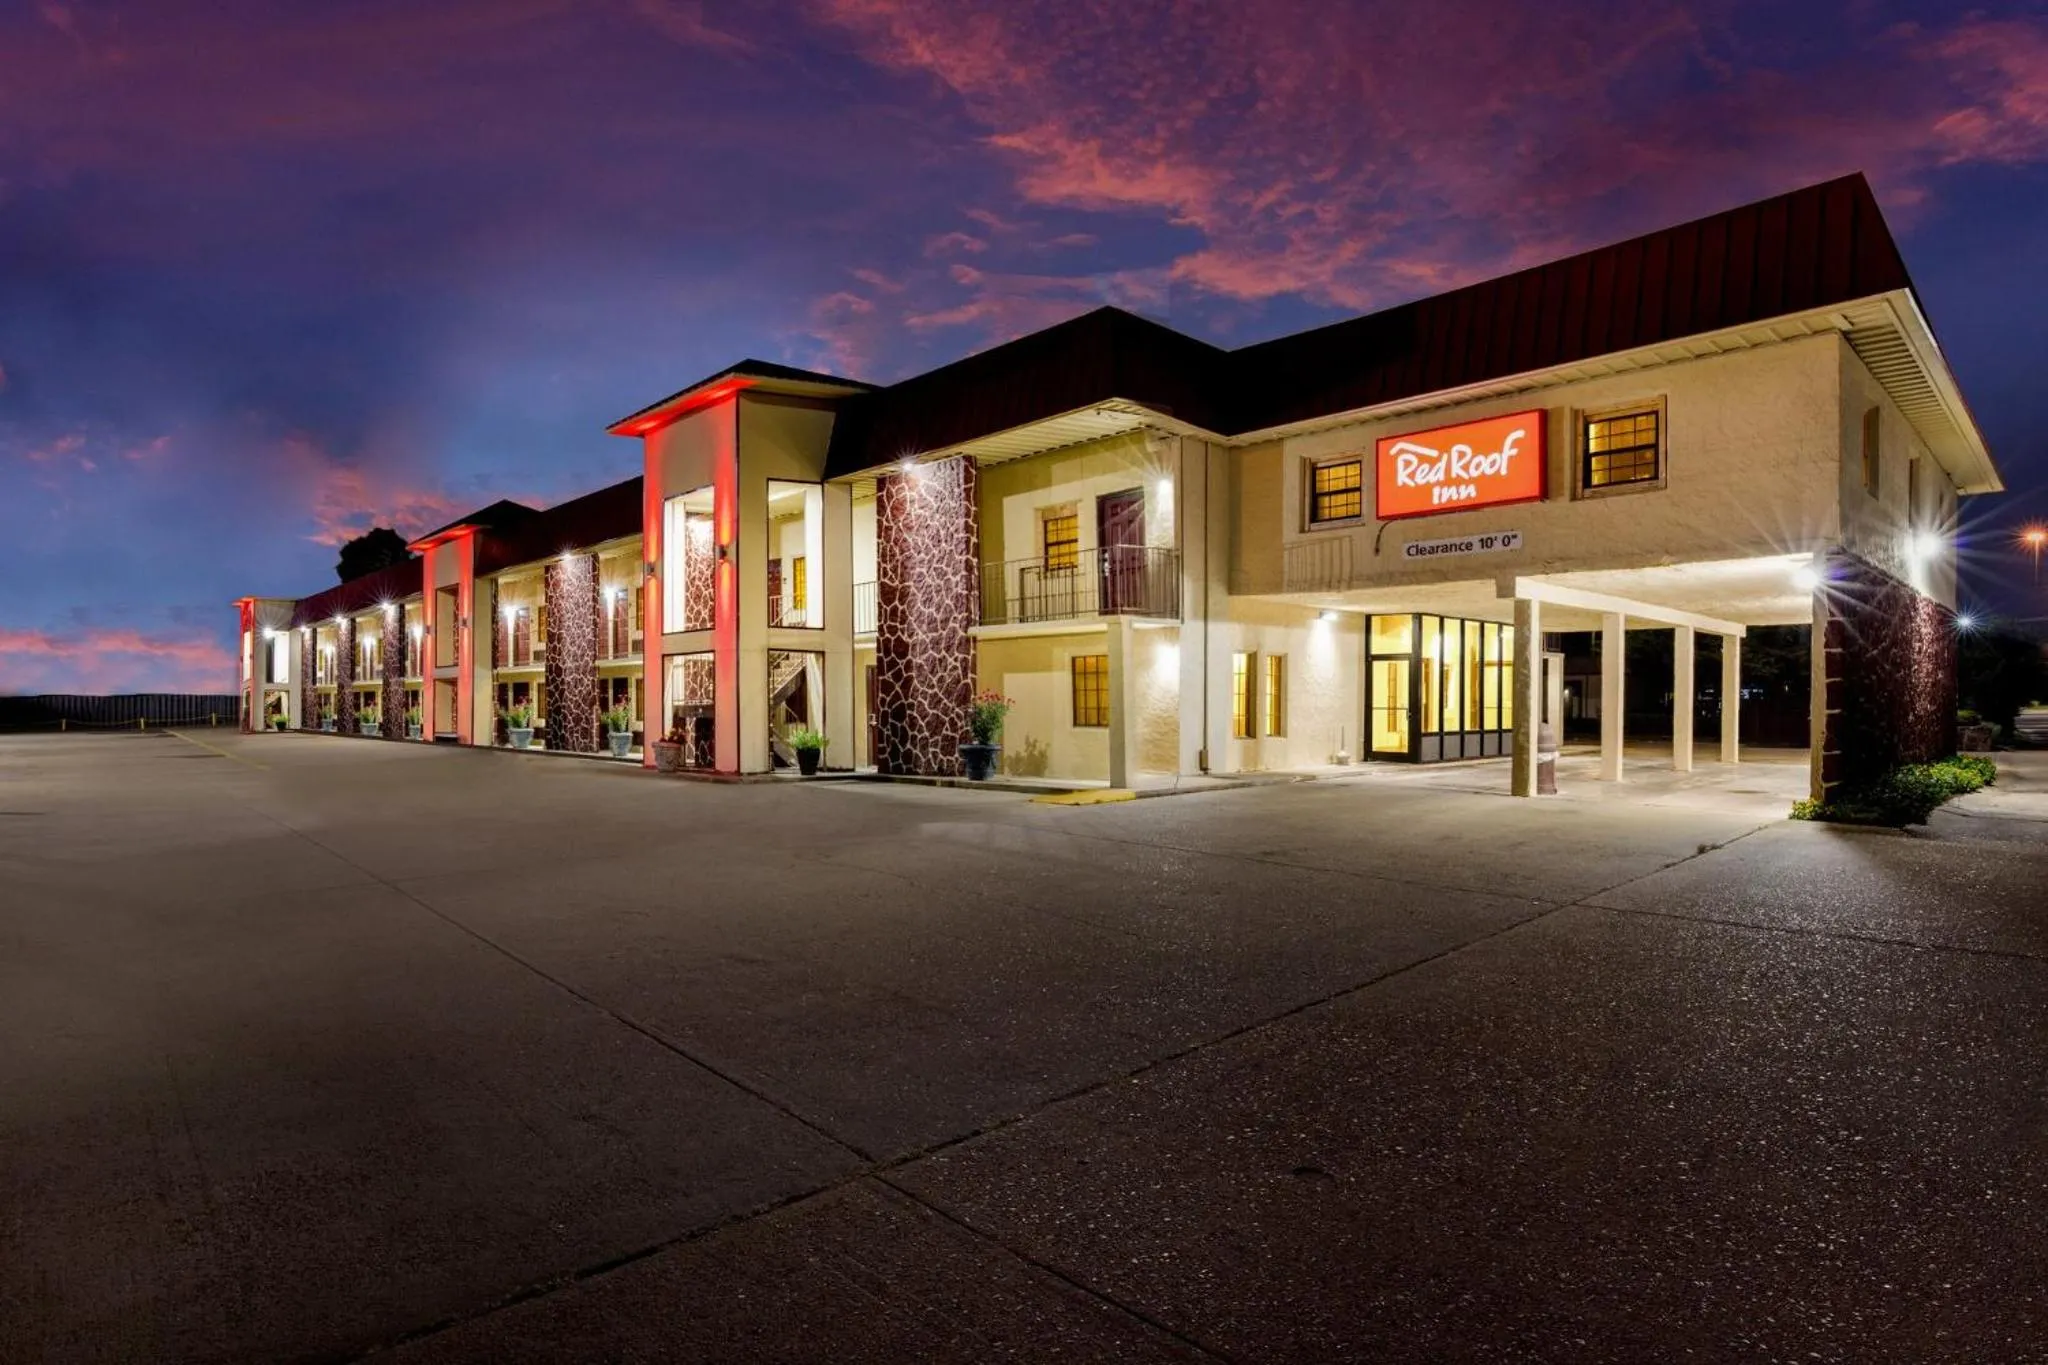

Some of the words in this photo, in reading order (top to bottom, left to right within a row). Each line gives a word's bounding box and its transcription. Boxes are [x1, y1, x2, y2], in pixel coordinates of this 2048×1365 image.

[1396, 453, 1448, 487] Red
[1450, 429, 1526, 479] Roof
[1406, 540, 1474, 557] Clearance
[1478, 537, 1498, 549] 10'
[1502, 534, 1518, 547] 0"
